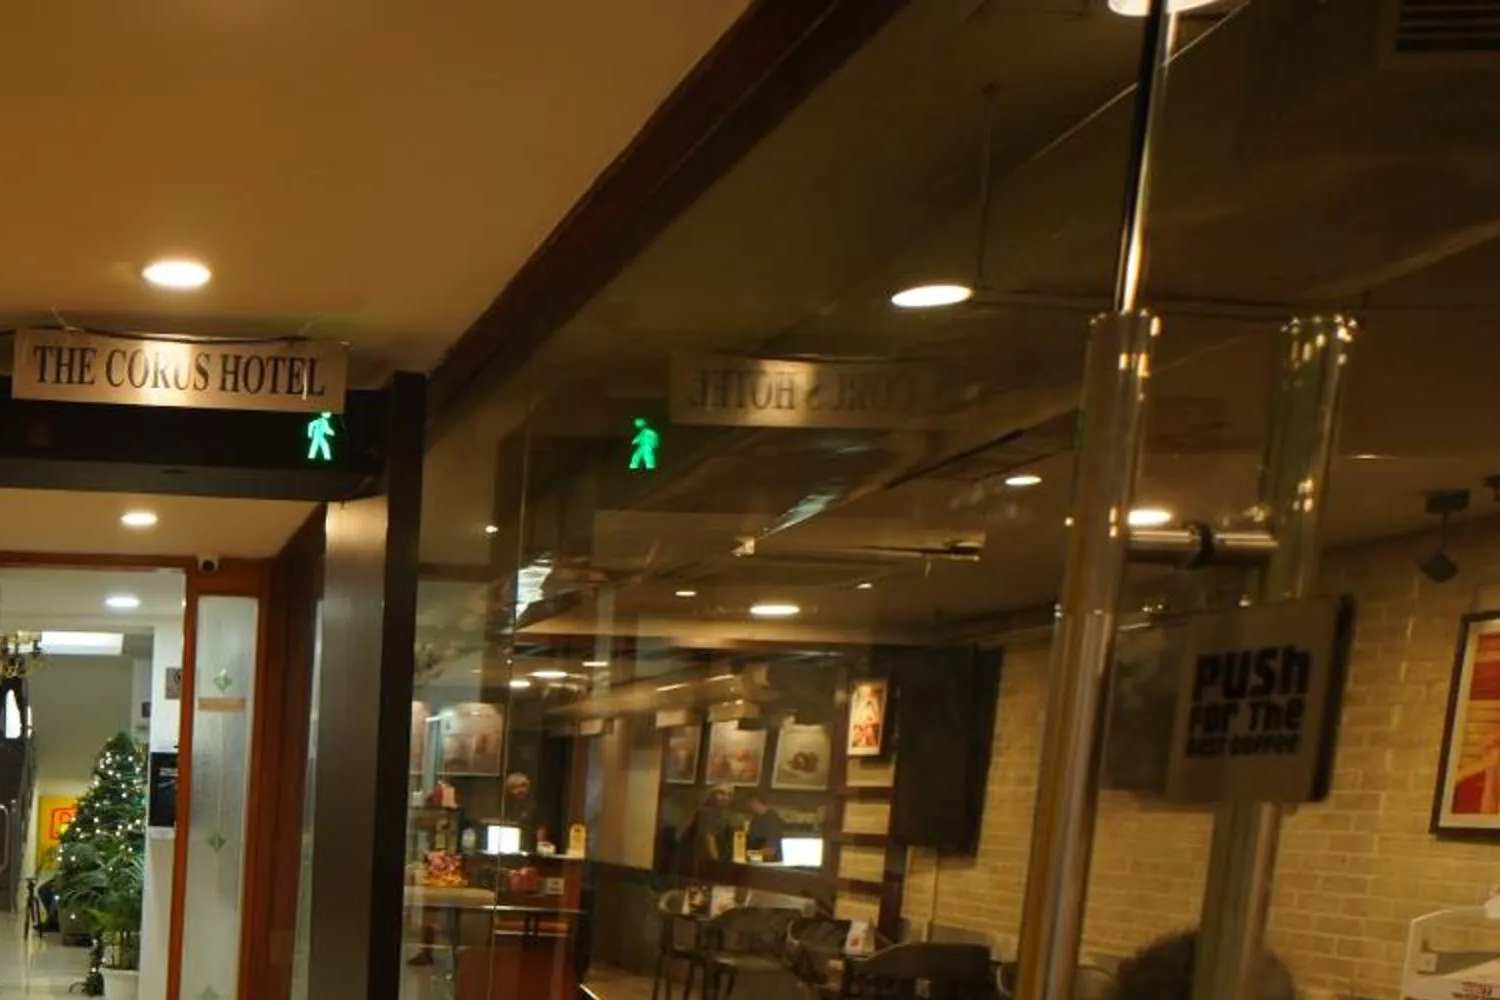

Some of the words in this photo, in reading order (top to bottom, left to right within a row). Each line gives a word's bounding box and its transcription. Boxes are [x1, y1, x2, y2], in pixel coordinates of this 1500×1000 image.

[33, 344, 97, 386] THE
[104, 348, 211, 392] CORUS
[218, 353, 327, 397] HOTEL
